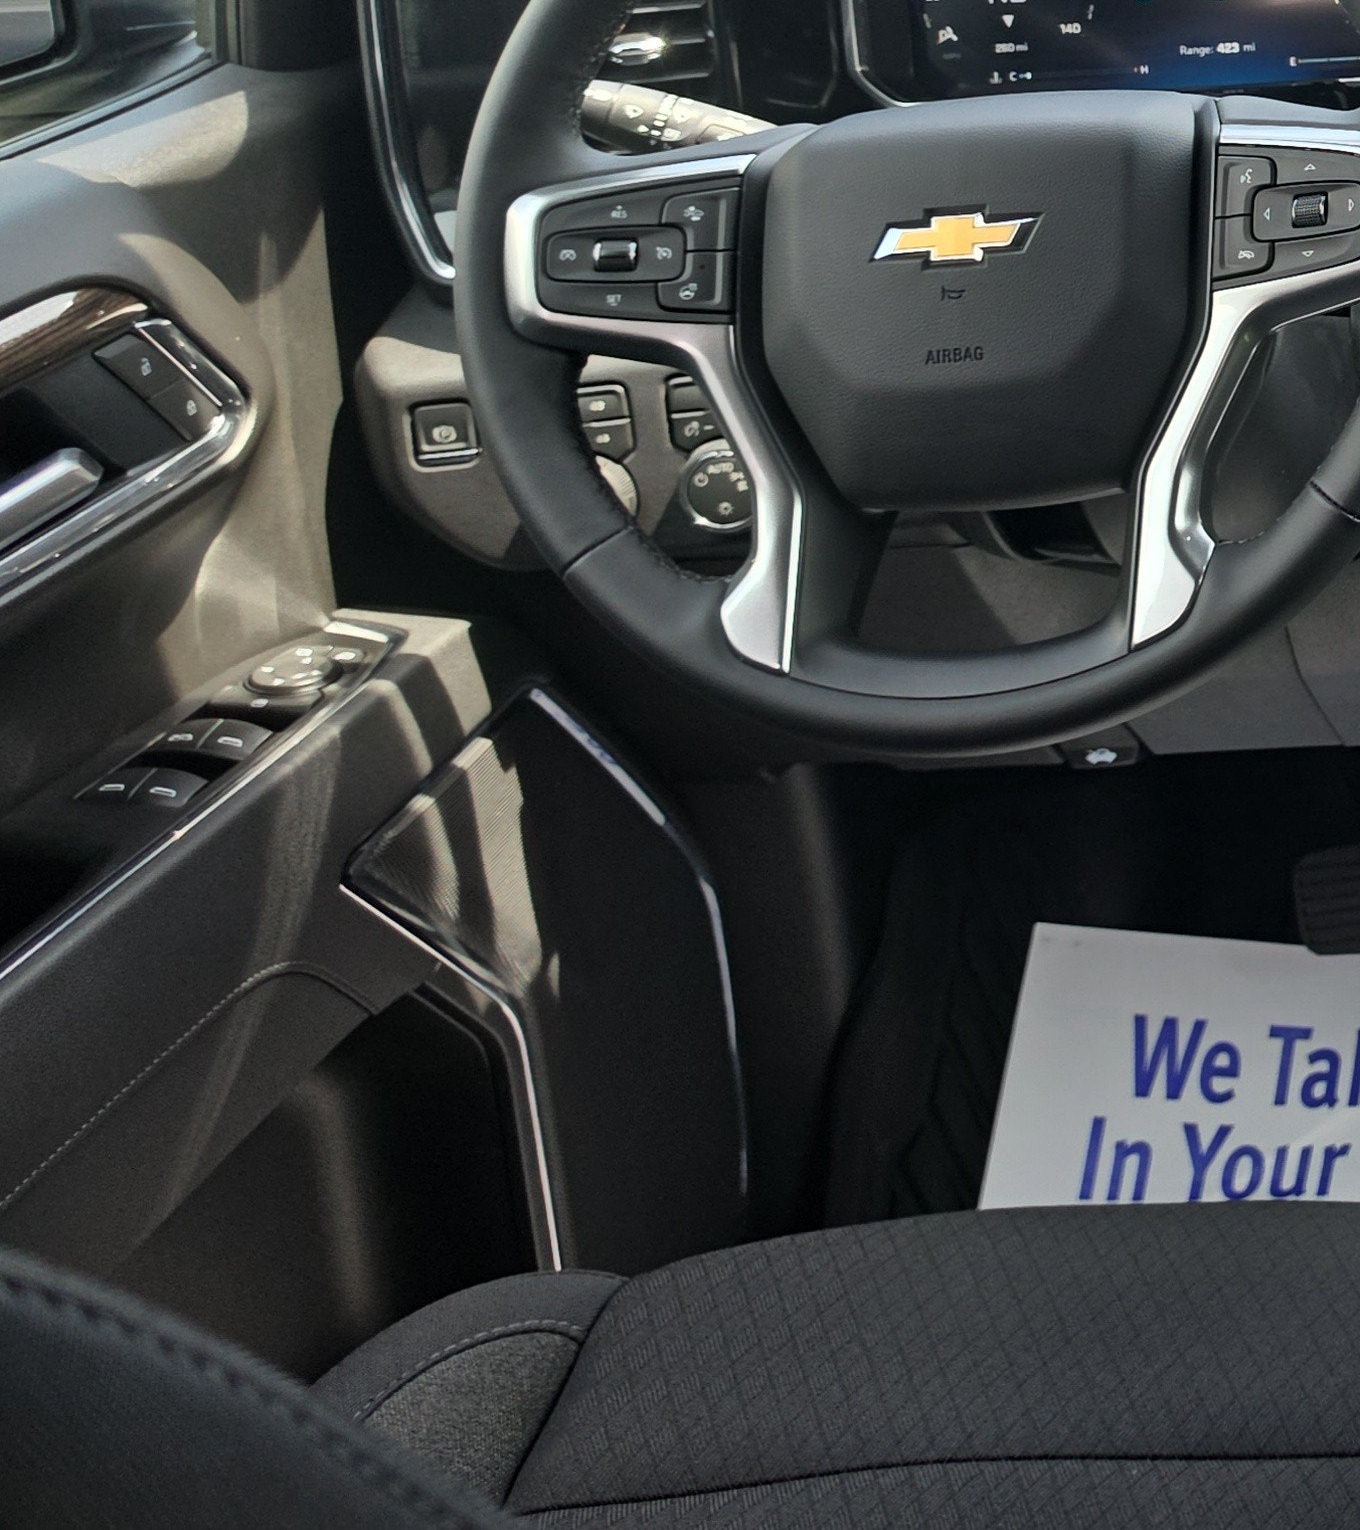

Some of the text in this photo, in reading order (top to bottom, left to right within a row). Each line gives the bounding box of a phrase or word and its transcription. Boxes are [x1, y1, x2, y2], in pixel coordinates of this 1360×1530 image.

[1059, 22, 1082, 34] 140
[1179, 42, 1256, 57] Range: 423 mi
[924, 345, 984, 366] AIRBAG
[707, 461, 735, 474] AUTO
[1131, 1014, 1242, 1106] We
[1077, 1116, 1155, 1202] In
[1182, 1123, 1351, 1202] Your
